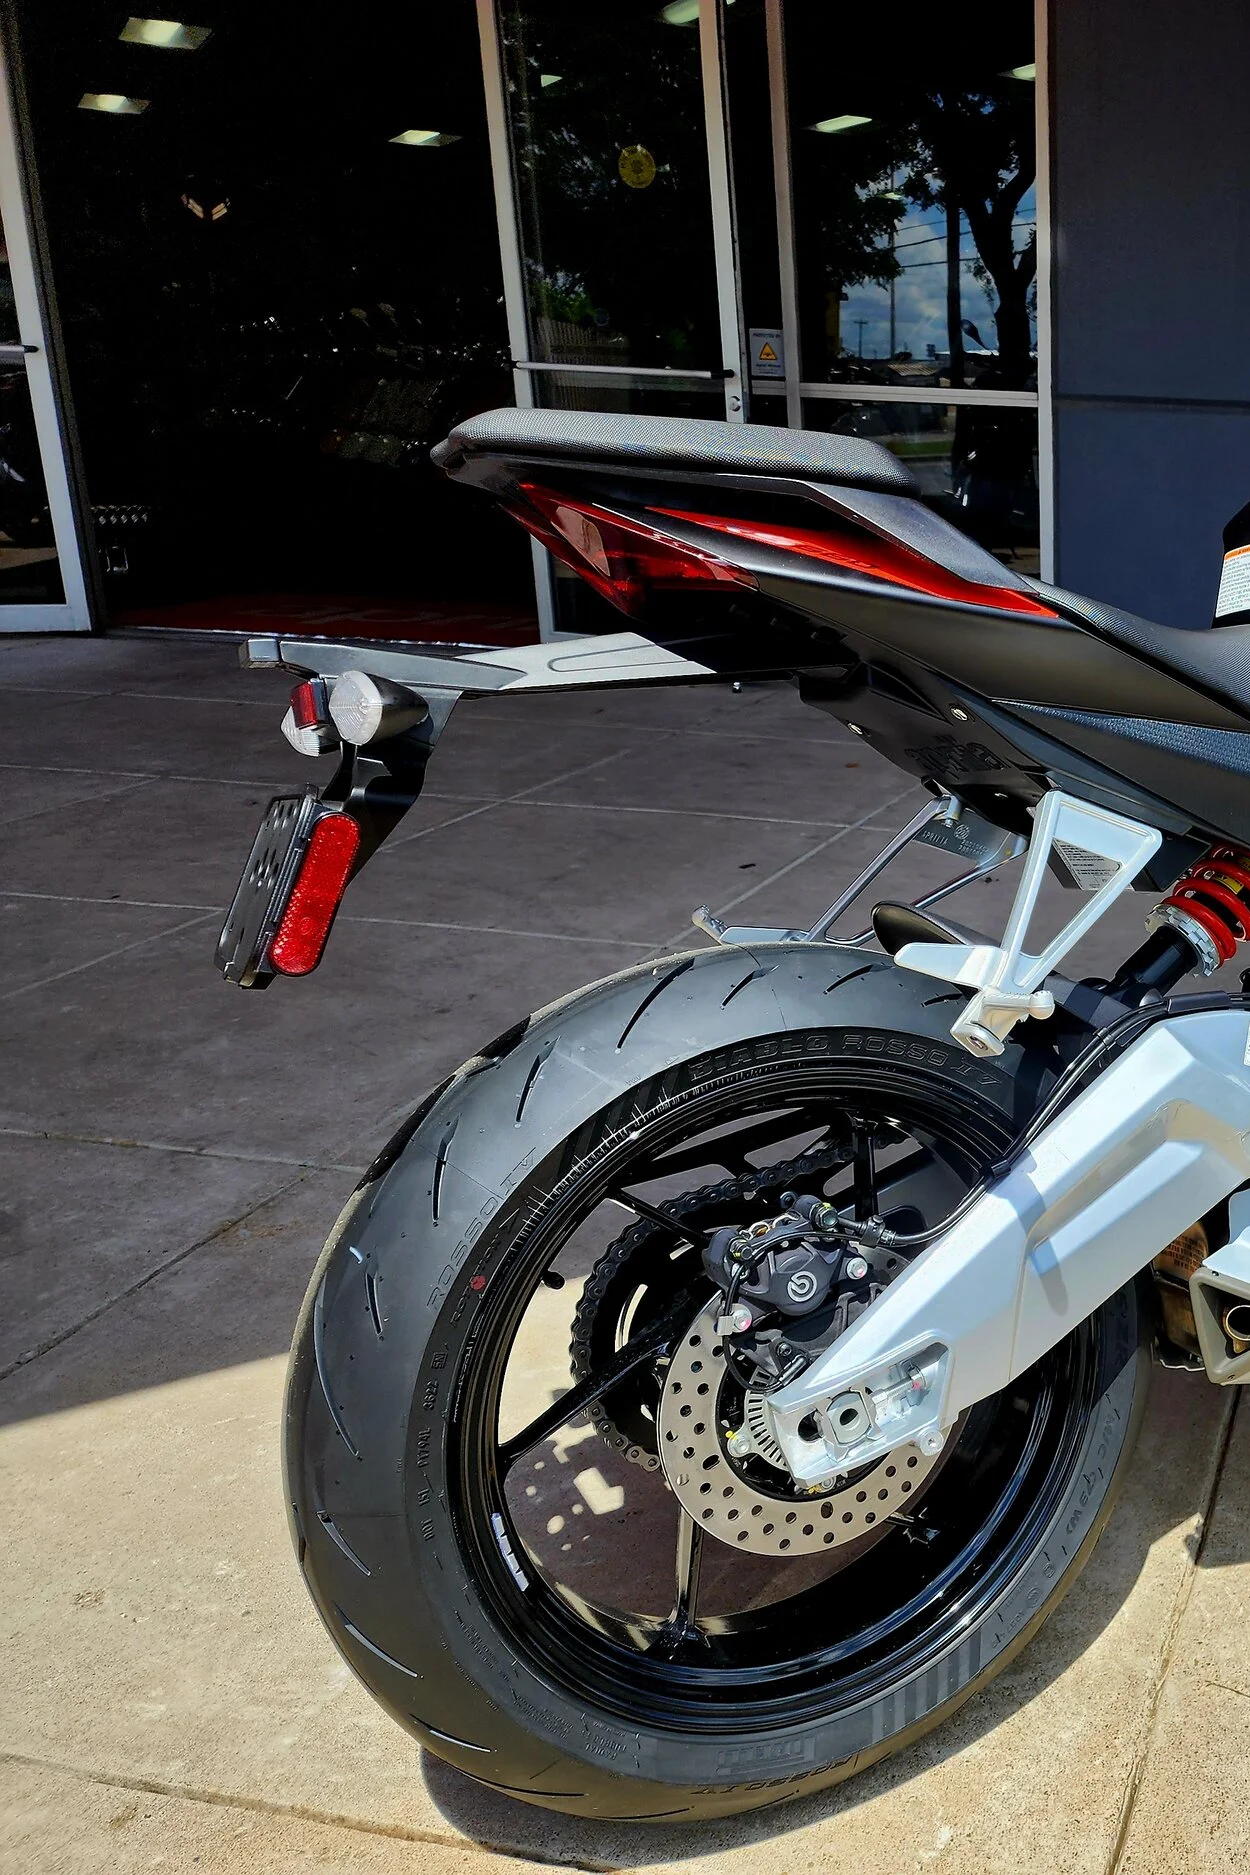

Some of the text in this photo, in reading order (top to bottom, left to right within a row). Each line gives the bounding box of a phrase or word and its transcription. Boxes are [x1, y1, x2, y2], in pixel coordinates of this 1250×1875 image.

[688, 1034, 829, 1081] DIABLO
[841, 1034, 949, 1066] ROSSO
[426, 1196, 499, 1308] ROSSO
